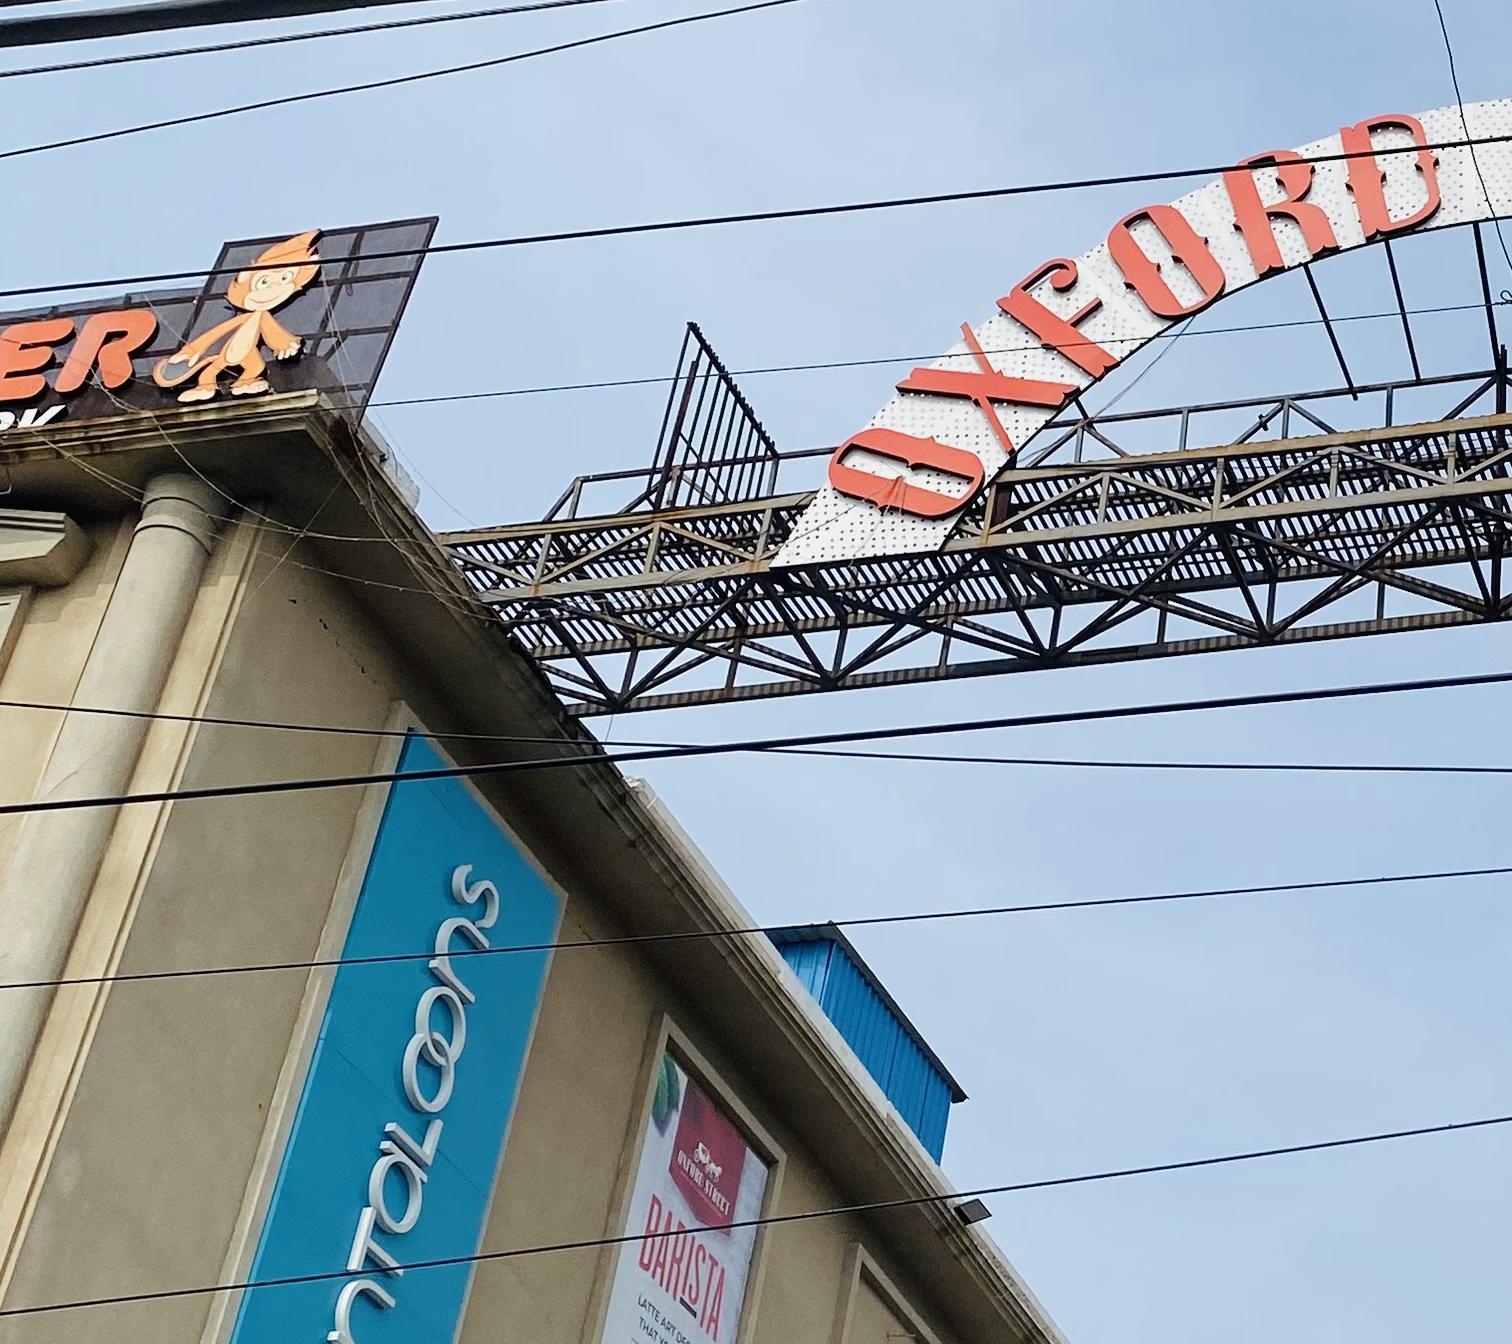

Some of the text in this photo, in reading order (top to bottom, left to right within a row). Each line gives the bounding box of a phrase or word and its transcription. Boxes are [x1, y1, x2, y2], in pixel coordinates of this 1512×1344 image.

[0, 309, 157, 402] ER
[828, 113, 1441, 519] OXFORD
[639, 1193, 725, 1343] BARISTA
[637, 1294, 660, 1323] LATTE
[660, 1317, 676, 1336] ART
[640, 1316, 658, 1342] THAT
